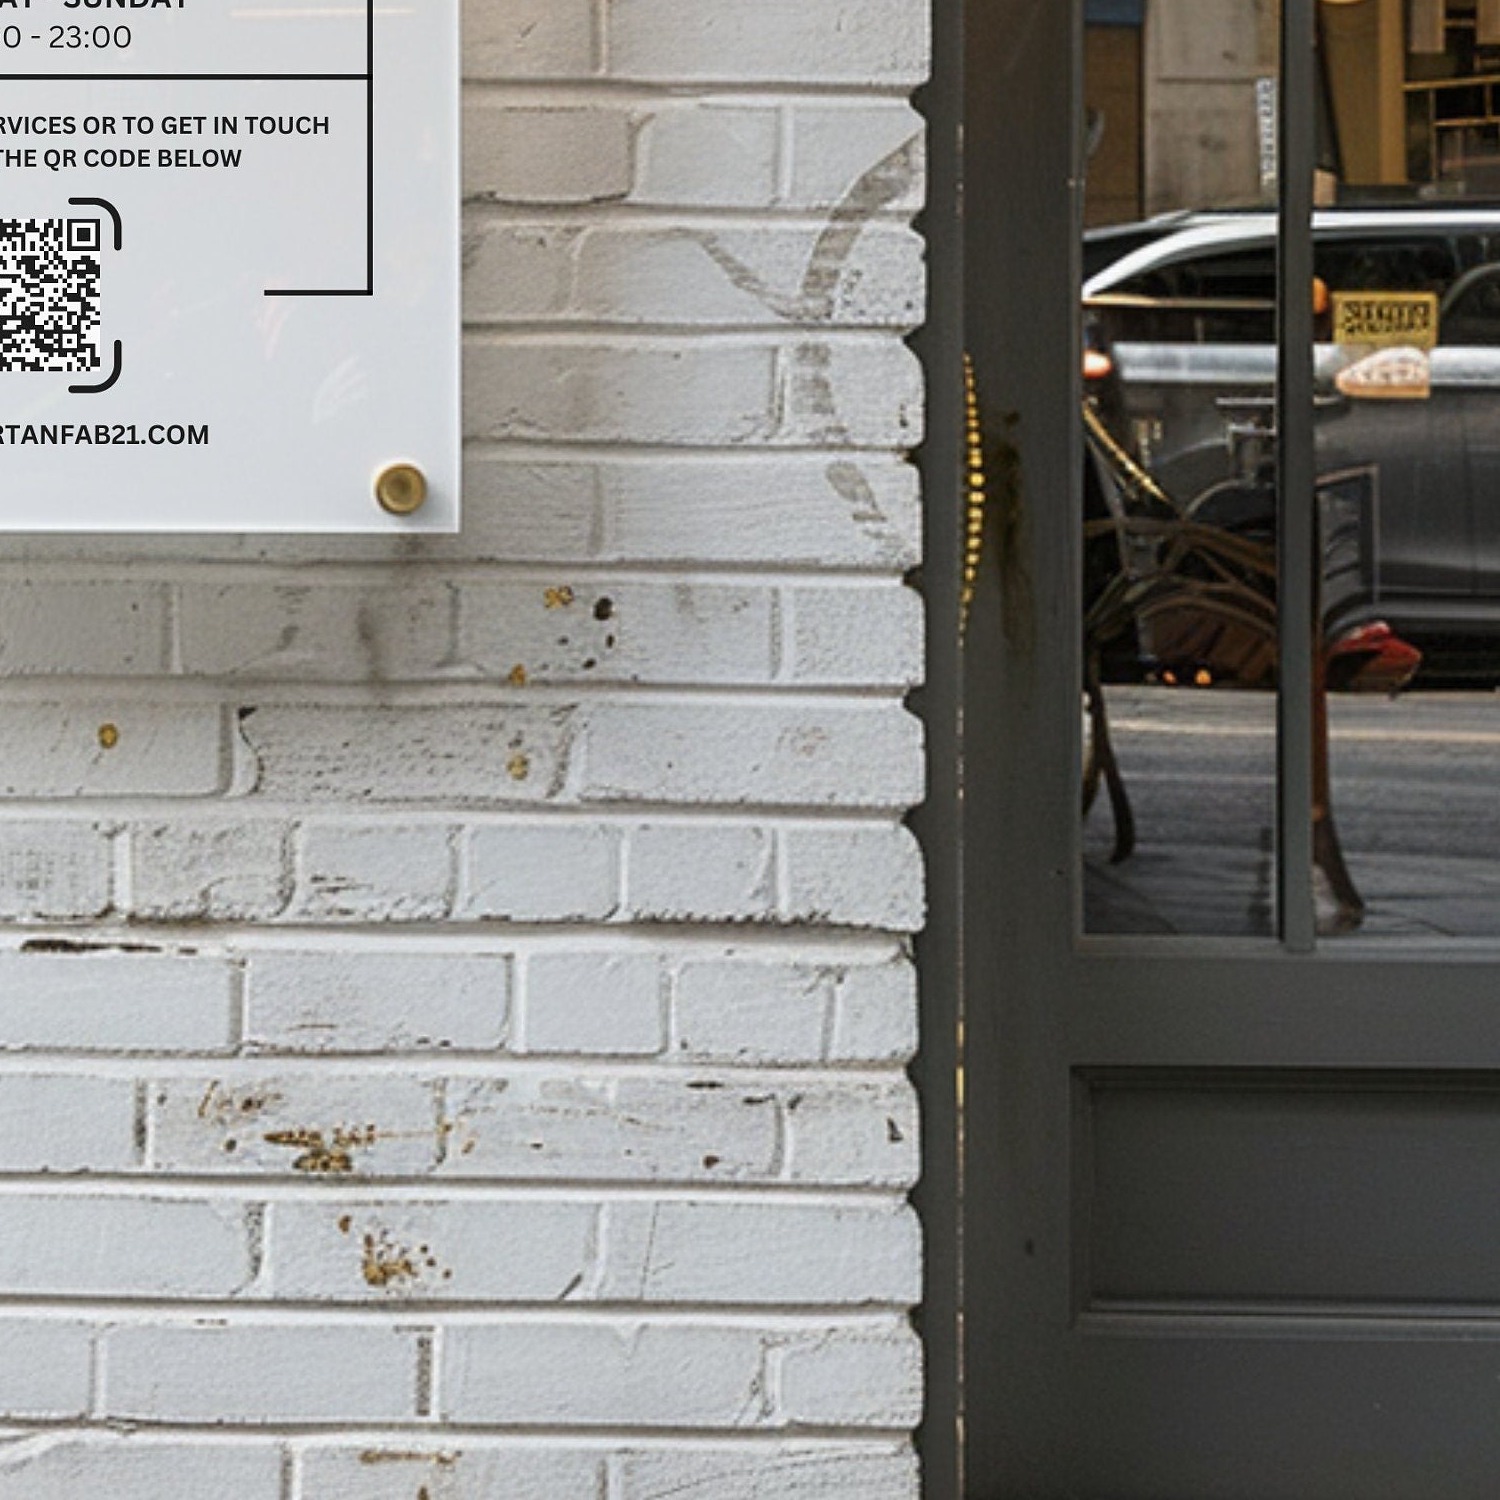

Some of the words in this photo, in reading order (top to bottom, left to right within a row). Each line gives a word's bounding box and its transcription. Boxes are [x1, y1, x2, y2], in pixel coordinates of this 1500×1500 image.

[49, 26, 131, 49] 23:00
[84, 117, 115, 134] OR
[123, 117, 153, 134] TO
[162, 117, 206, 134] GET
[215, 117, 237, 134] IN
[245, 117, 328, 134] TOUCH
[44, 150, 76, 171] QR
[84, 150, 150, 167] CODE
[159, 150, 241, 167] BELOW
